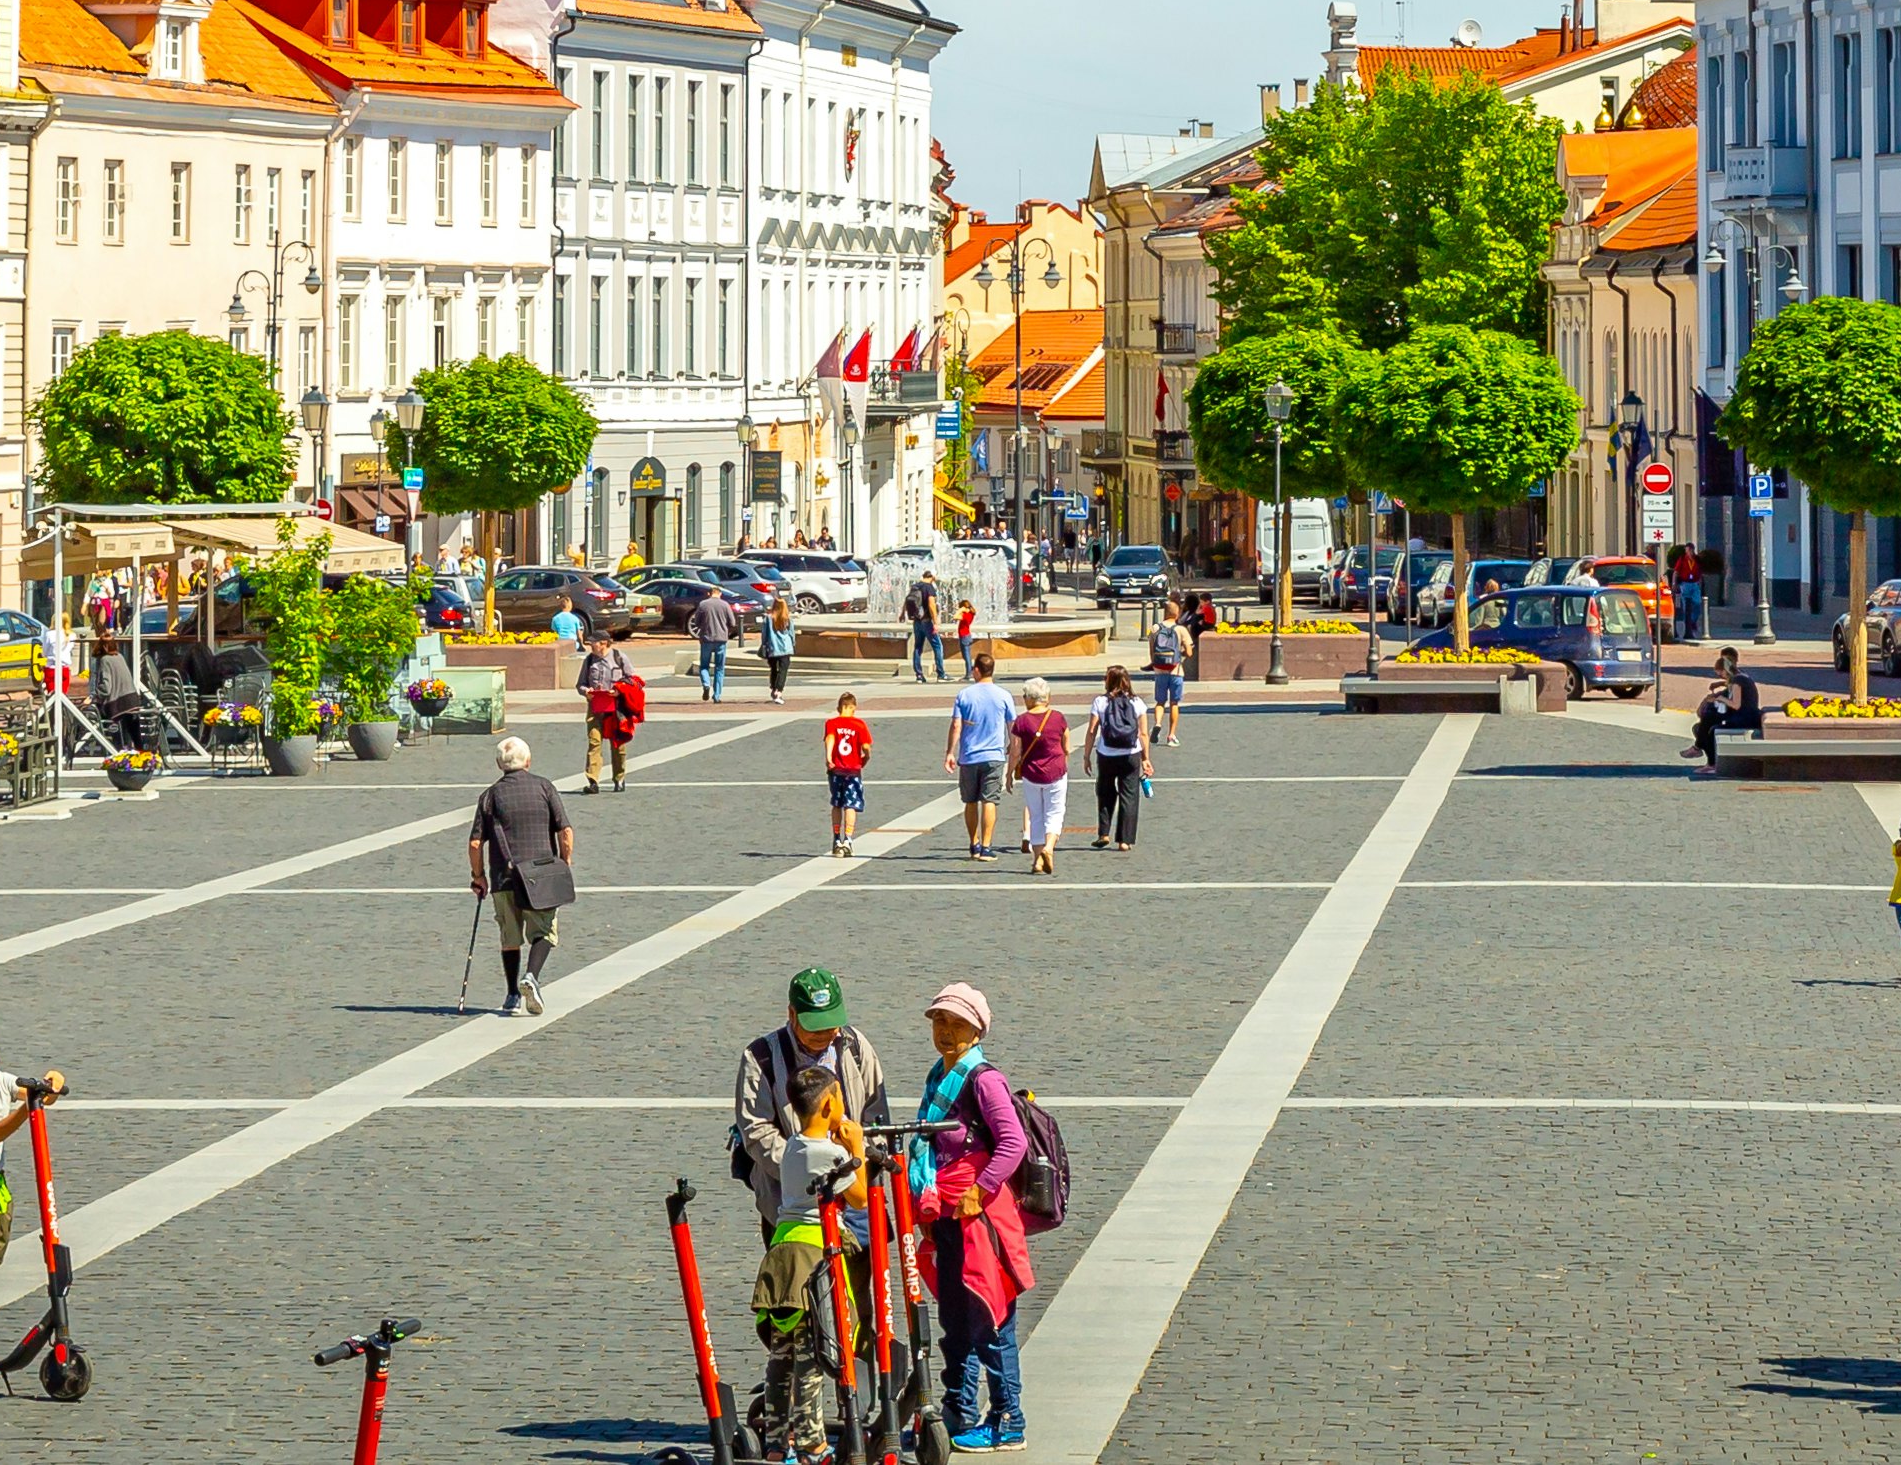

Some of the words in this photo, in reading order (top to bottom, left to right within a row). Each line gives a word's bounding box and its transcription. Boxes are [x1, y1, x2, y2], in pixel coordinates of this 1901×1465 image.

[1755, 478, 1768, 497] P
[839, 734, 853, 756] 6
[902, 1232, 921, 1297] citybee
